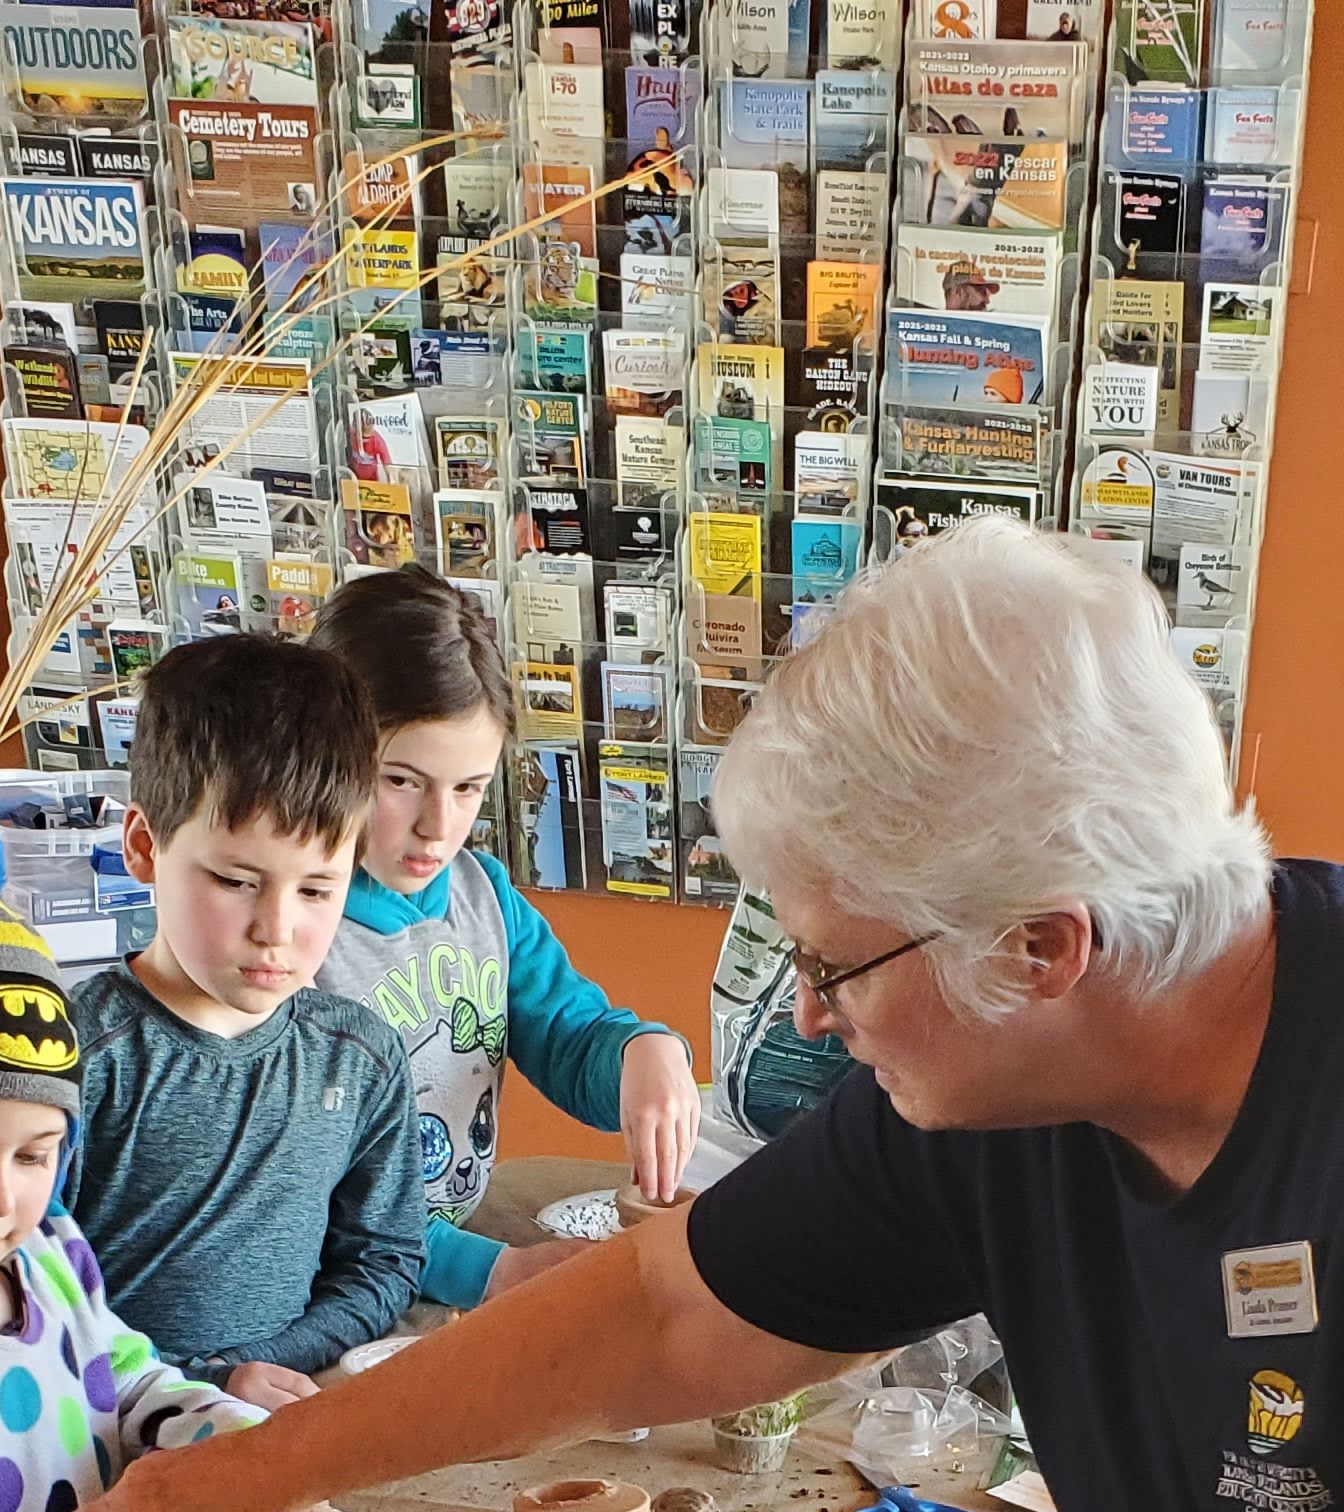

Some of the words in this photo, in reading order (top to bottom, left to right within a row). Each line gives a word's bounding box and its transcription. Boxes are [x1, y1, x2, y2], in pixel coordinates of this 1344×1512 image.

[567, 3, 598, 19] Miles
[657, 4, 678, 19] EX
[833, 5, 885, 21] Wilson
[657, 21, 675, 36] PL
[4, 26, 137, 70] OUTDOORS
[920, 62, 959, 74] Kansas
[961, 64, 996, 75] Otoño
[998, 67, 1006, 78] y
[1007, 64, 1067, 78] primavera
[822, 82, 887, 99] Kanopolis
[977, 79, 1004, 96] de
[1009, 82, 1058, 97] caza
[743, 103, 773, 114] State
[822, 97, 851, 110] Lake
[179, 109, 256, 141] Cemetery
[258, 113, 309, 138] Tours
[771, 118, 804, 130] Trails
[10, 147, 66, 166] KANSAS
[92, 152, 151, 171] KANSAS
[1003, 152, 1058, 169] Pescar
[975, 166, 995, 180] en
[999, 166, 1057, 182] Kansas
[7, 193, 137, 247] KANSAS
[898, 331, 939, 344] Kansas
[940, 331, 961, 344] Fall
[964, 335, 972, 346] &
[974, 337, 1011, 352] Spring
[1092, 385, 1146, 397] NATURE
[1093, 405, 1144, 424] YOU
[902, 418, 961, 440] Kansas
[965, 425, 1034, 449] Hunting
[800, 455, 818, 464] THE
[819, 455, 833, 465] BIG
[835, 456, 858, 467] WELL
[1179, 469, 1197, 482] VAN
[1199, 471, 1232, 487] TOURS
[960, 498, 1021, 519] Kansas
[371, 952, 430, 1035] AY
[427, 943, 507, 1021] COO
